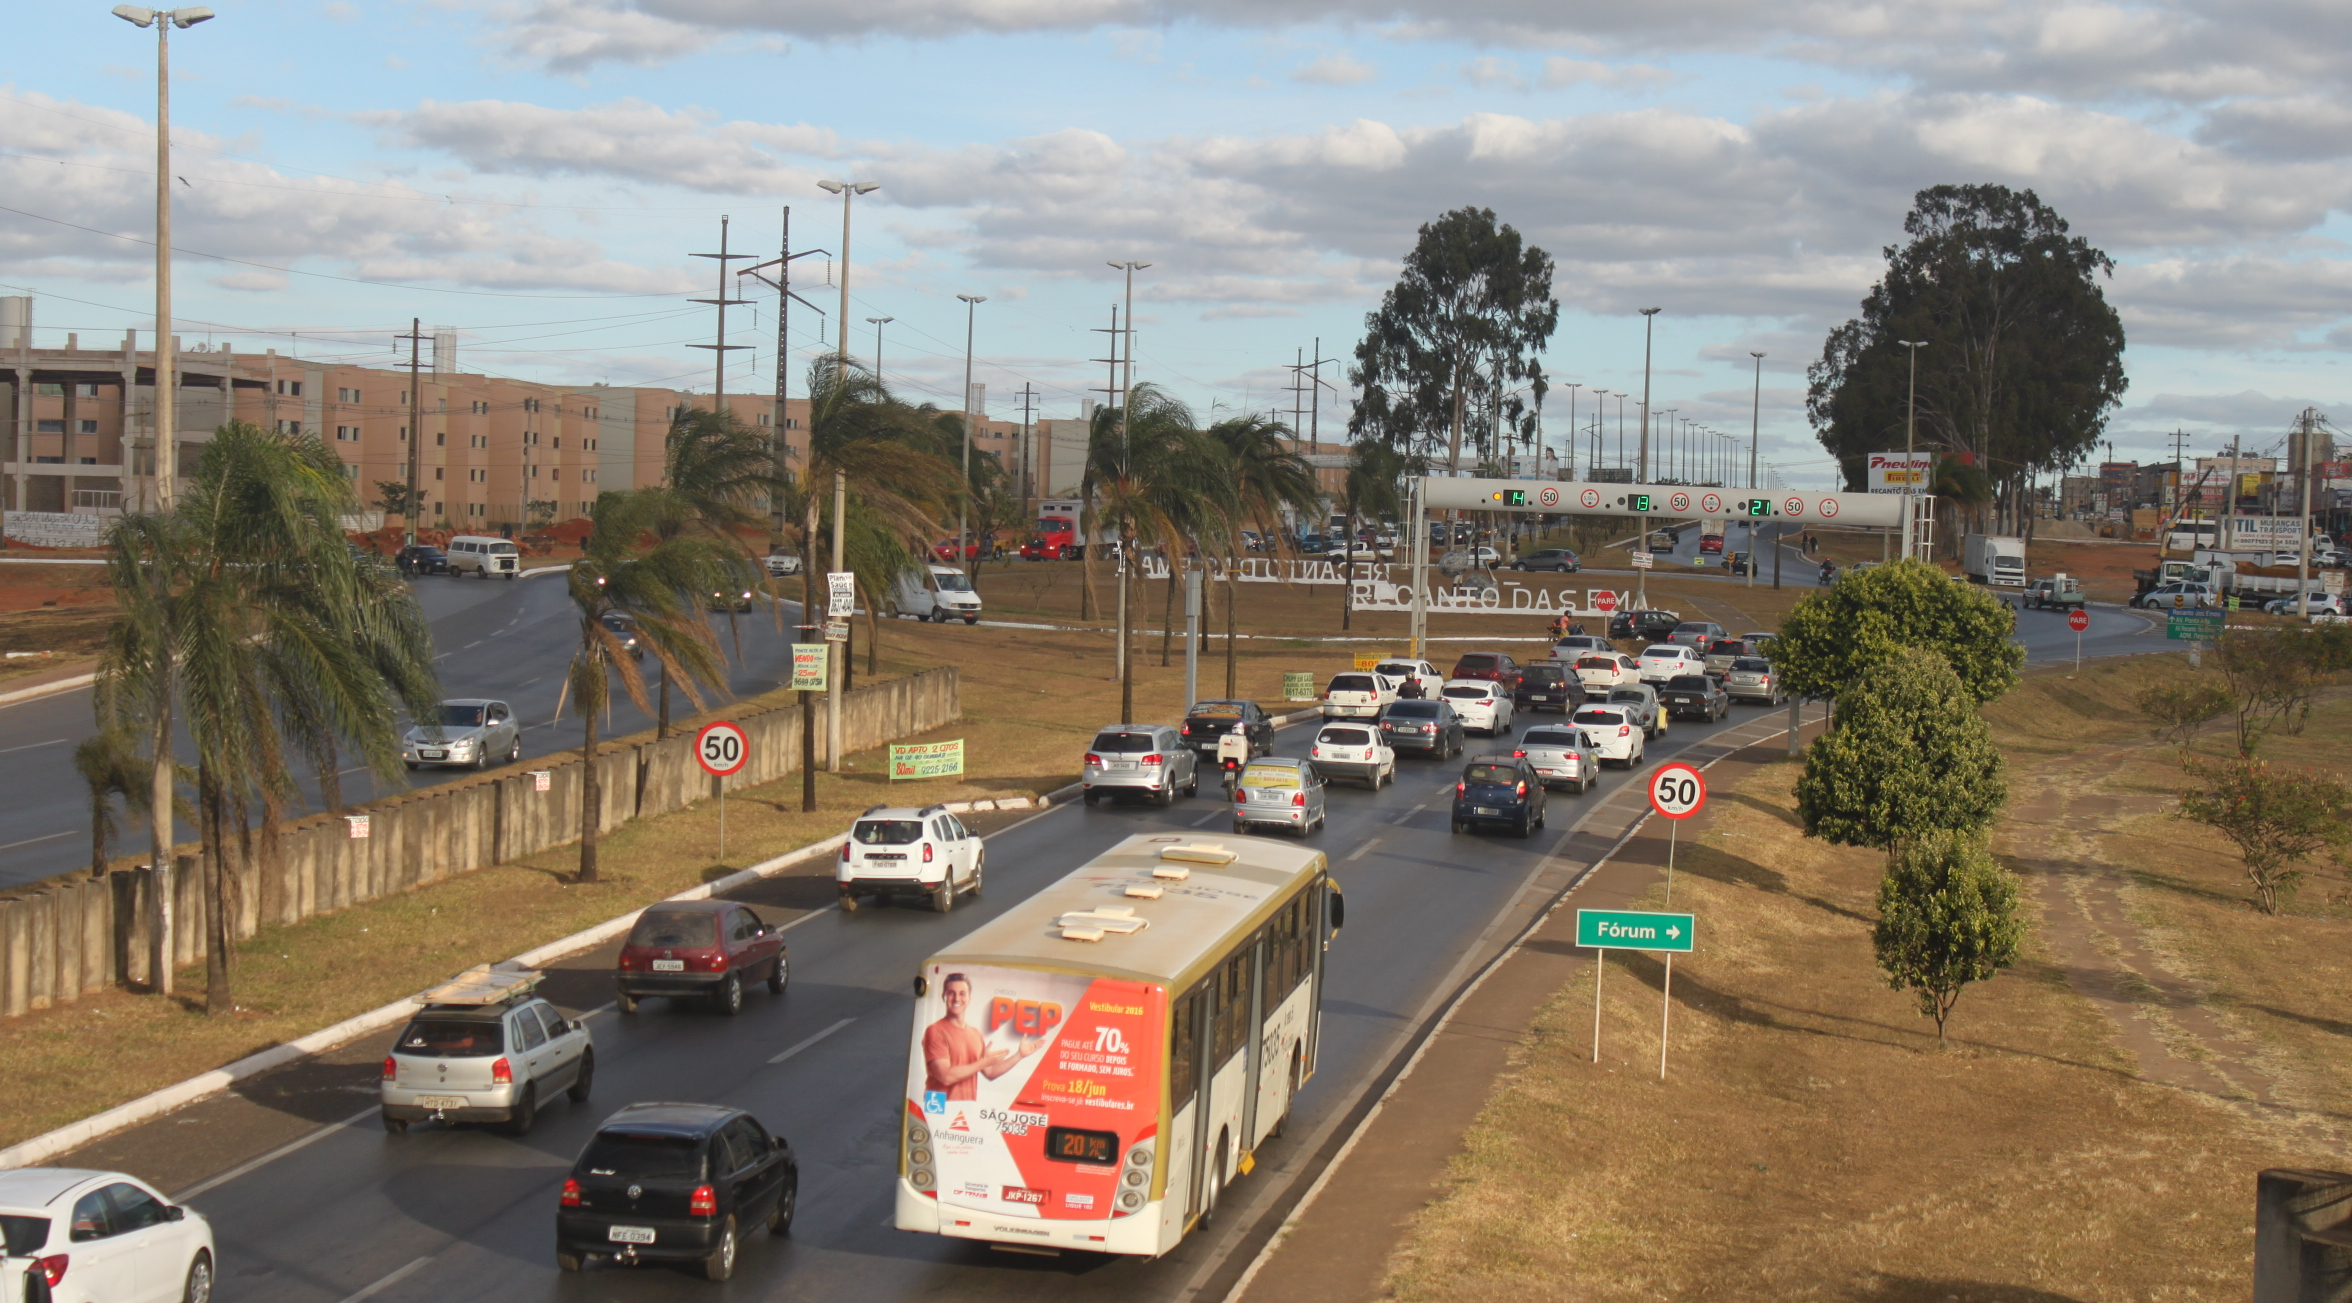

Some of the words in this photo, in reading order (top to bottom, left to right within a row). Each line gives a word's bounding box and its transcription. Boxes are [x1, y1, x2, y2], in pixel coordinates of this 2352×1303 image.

[1512, 492, 1524, 505] 14
[1543, 492, 1556, 502] 50
[1636, 496, 1648, 510] 13
[1674, 498, 1686, 506] 50
[1752, 500, 1770, 515] 21
[1788, 502, 1800, 512] 50
[1512, 588, 1577, 611] DAS
[704, 736, 739, 762] 50
[940, 743, 958, 752] QTOS
[1658, 777, 1695, 805] 50
[1598, 921, 1656, 939] Fórum
[1089, 1002, 1124, 1014] Vestibular
[1125, 1006, 1144, 1015] 2016
[990, 996, 1062, 1036] PEP
[1061, 1039, 1080, 1050] PAGUE
[1082, 1040, 1094, 1050] ATÉ
[1094, 1026, 1129, 1054] 70%
[1060, 1051, 1069, 1060] DO
[1070, 1052, 1082, 1061] SEU
[1083, 1053, 1104, 1063] CURSO
[1106, 1055, 1126, 1065] DEPOIS
[1060, 1062, 1067, 1070] DE
[1068, 1062, 1098, 1074] FORMADO,
[1099, 1065, 1111, 1074] SEM
[1043, 1080, 1066, 1092] Prova
[1067, 1080, 1106, 1097] 18/jun
[1041, 1093, 1074, 1104] Inscreva-se
[1085, 1098, 1134, 1110] vestibulares.br
[980, 1109, 1008, 1122] SÃO
[1011, 1112, 1047, 1127] JOSÉ
[995, 1122, 1027, 1135] 75035
[933, 1129, 984, 1145] Anhanguera
[1063, 1134, 1085, 1156] 20
[1006, 1191, 1043, 1202] JKP-1267
[994, 1226, 1050, 1236] VOLKSWAGEN
